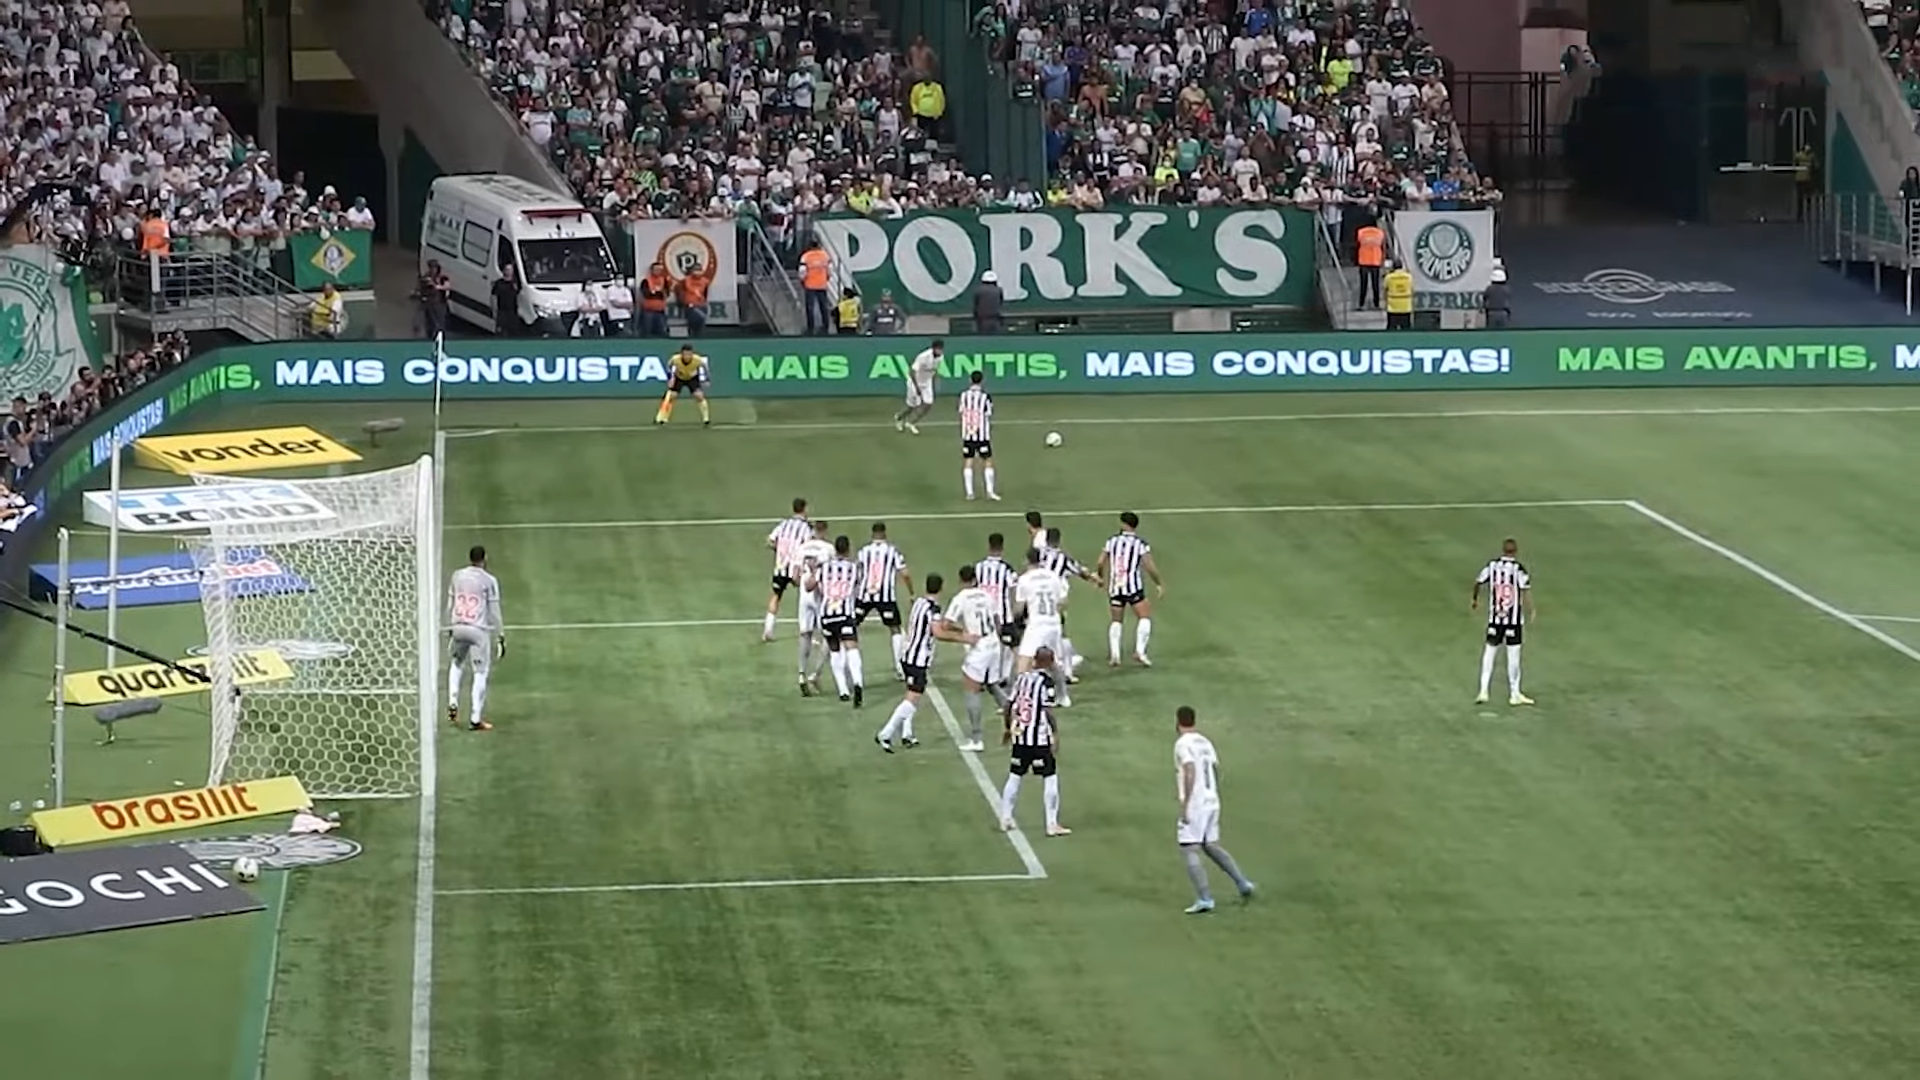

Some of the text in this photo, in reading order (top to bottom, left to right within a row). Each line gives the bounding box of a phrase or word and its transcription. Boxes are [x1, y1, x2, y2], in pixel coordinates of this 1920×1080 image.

[814, 209, 1288, 302] PORK'S
[276, 359, 385, 385] MAIS
[741, 354, 850, 380] MAIS
[1086, 348, 1511, 376] MAIS CONQUISTAS!
[1558, 345, 1877, 372] MAIS AVANTIS,
[162, 437, 329, 463] vonder
[92, 784, 258, 831] brasilit
